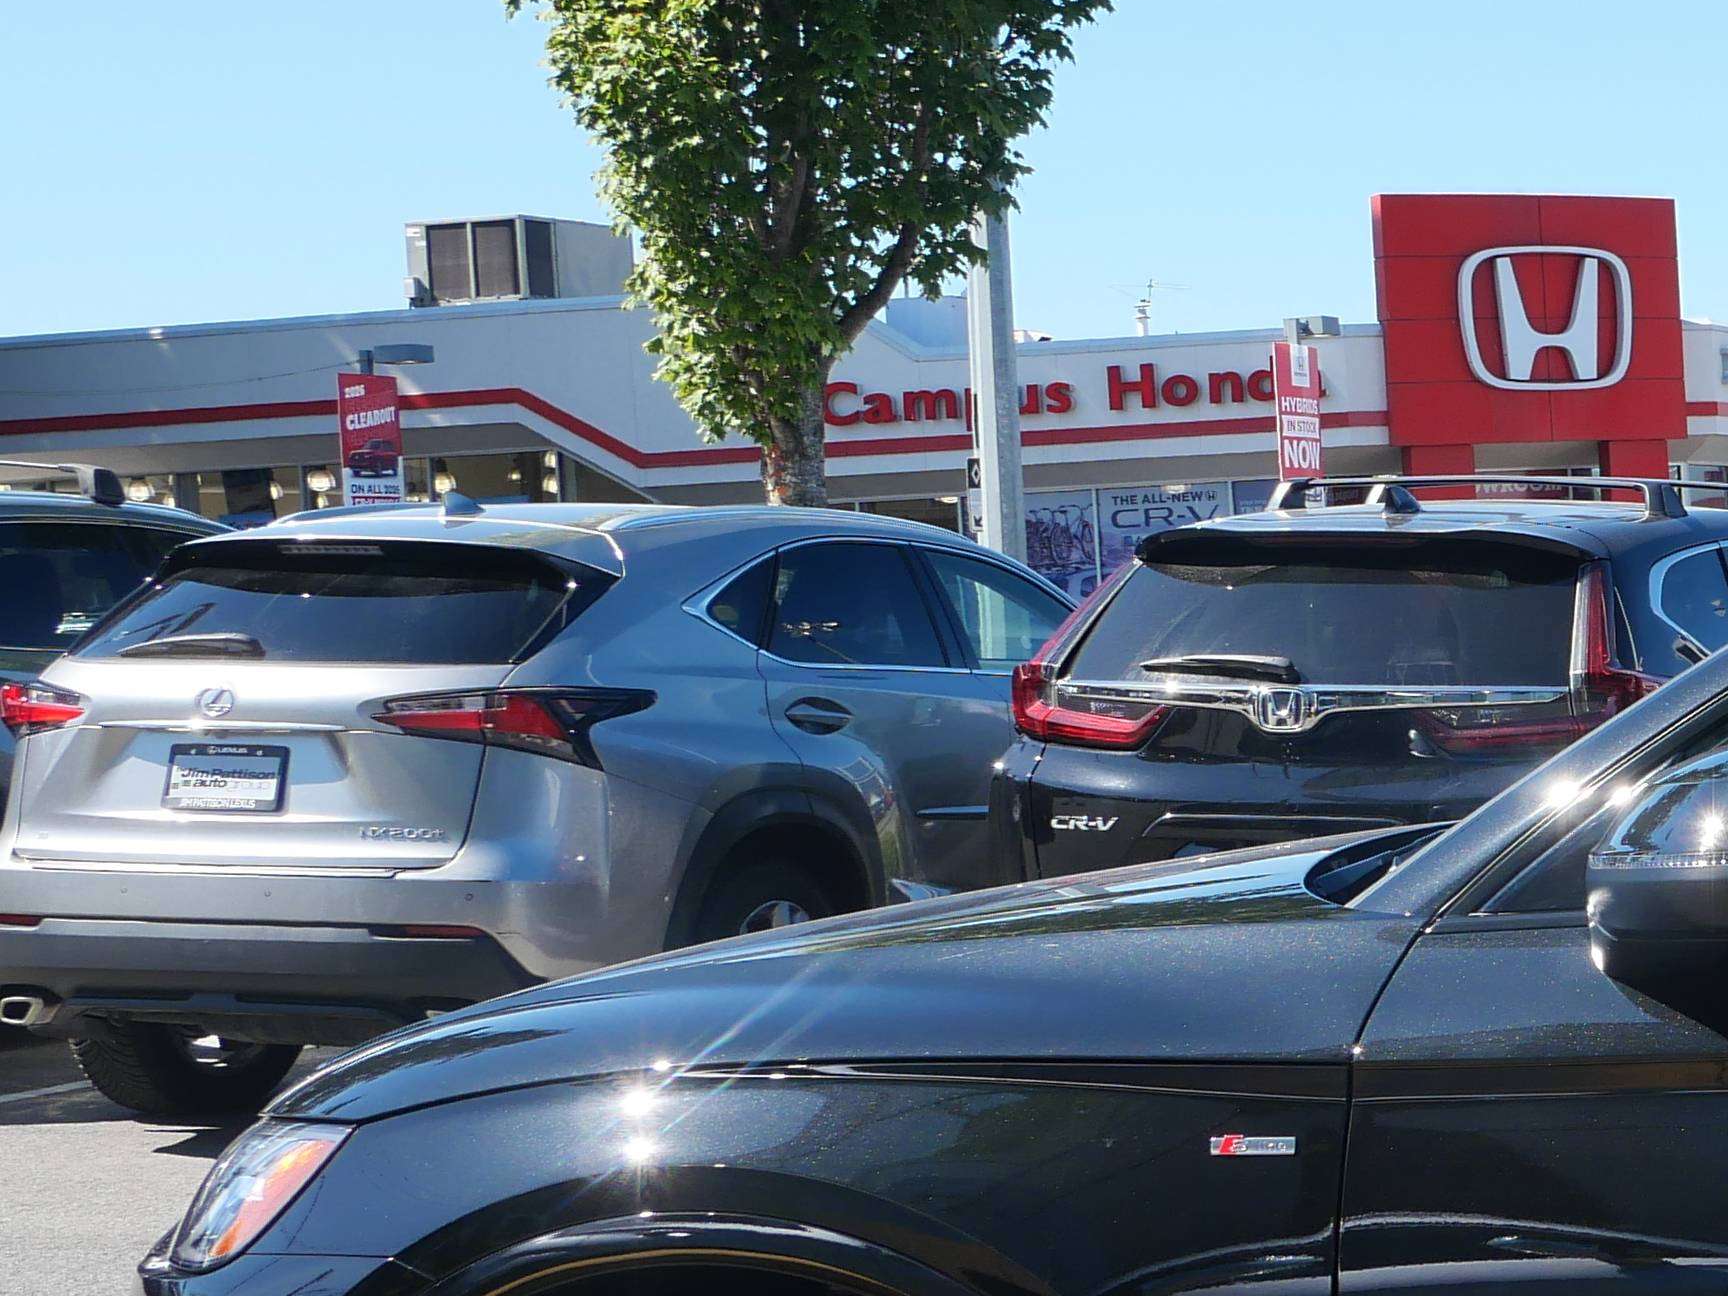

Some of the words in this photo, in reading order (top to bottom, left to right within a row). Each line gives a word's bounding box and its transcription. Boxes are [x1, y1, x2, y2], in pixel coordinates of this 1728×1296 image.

[824, 380, 1075, 431] Camus
[1107, 355, 1327, 411] Hond
[345, 405, 396, 431] CLEAROUT
[1287, 420, 1297, 432] IN
[1284, 439, 1321, 470] NOW
[1112, 495, 1138, 505] THE
[1142, 491, 1203, 505] ALL-NEW
[1111, 504, 1220, 529] CR-V
[1050, 815, 1120, 832] CR-V
